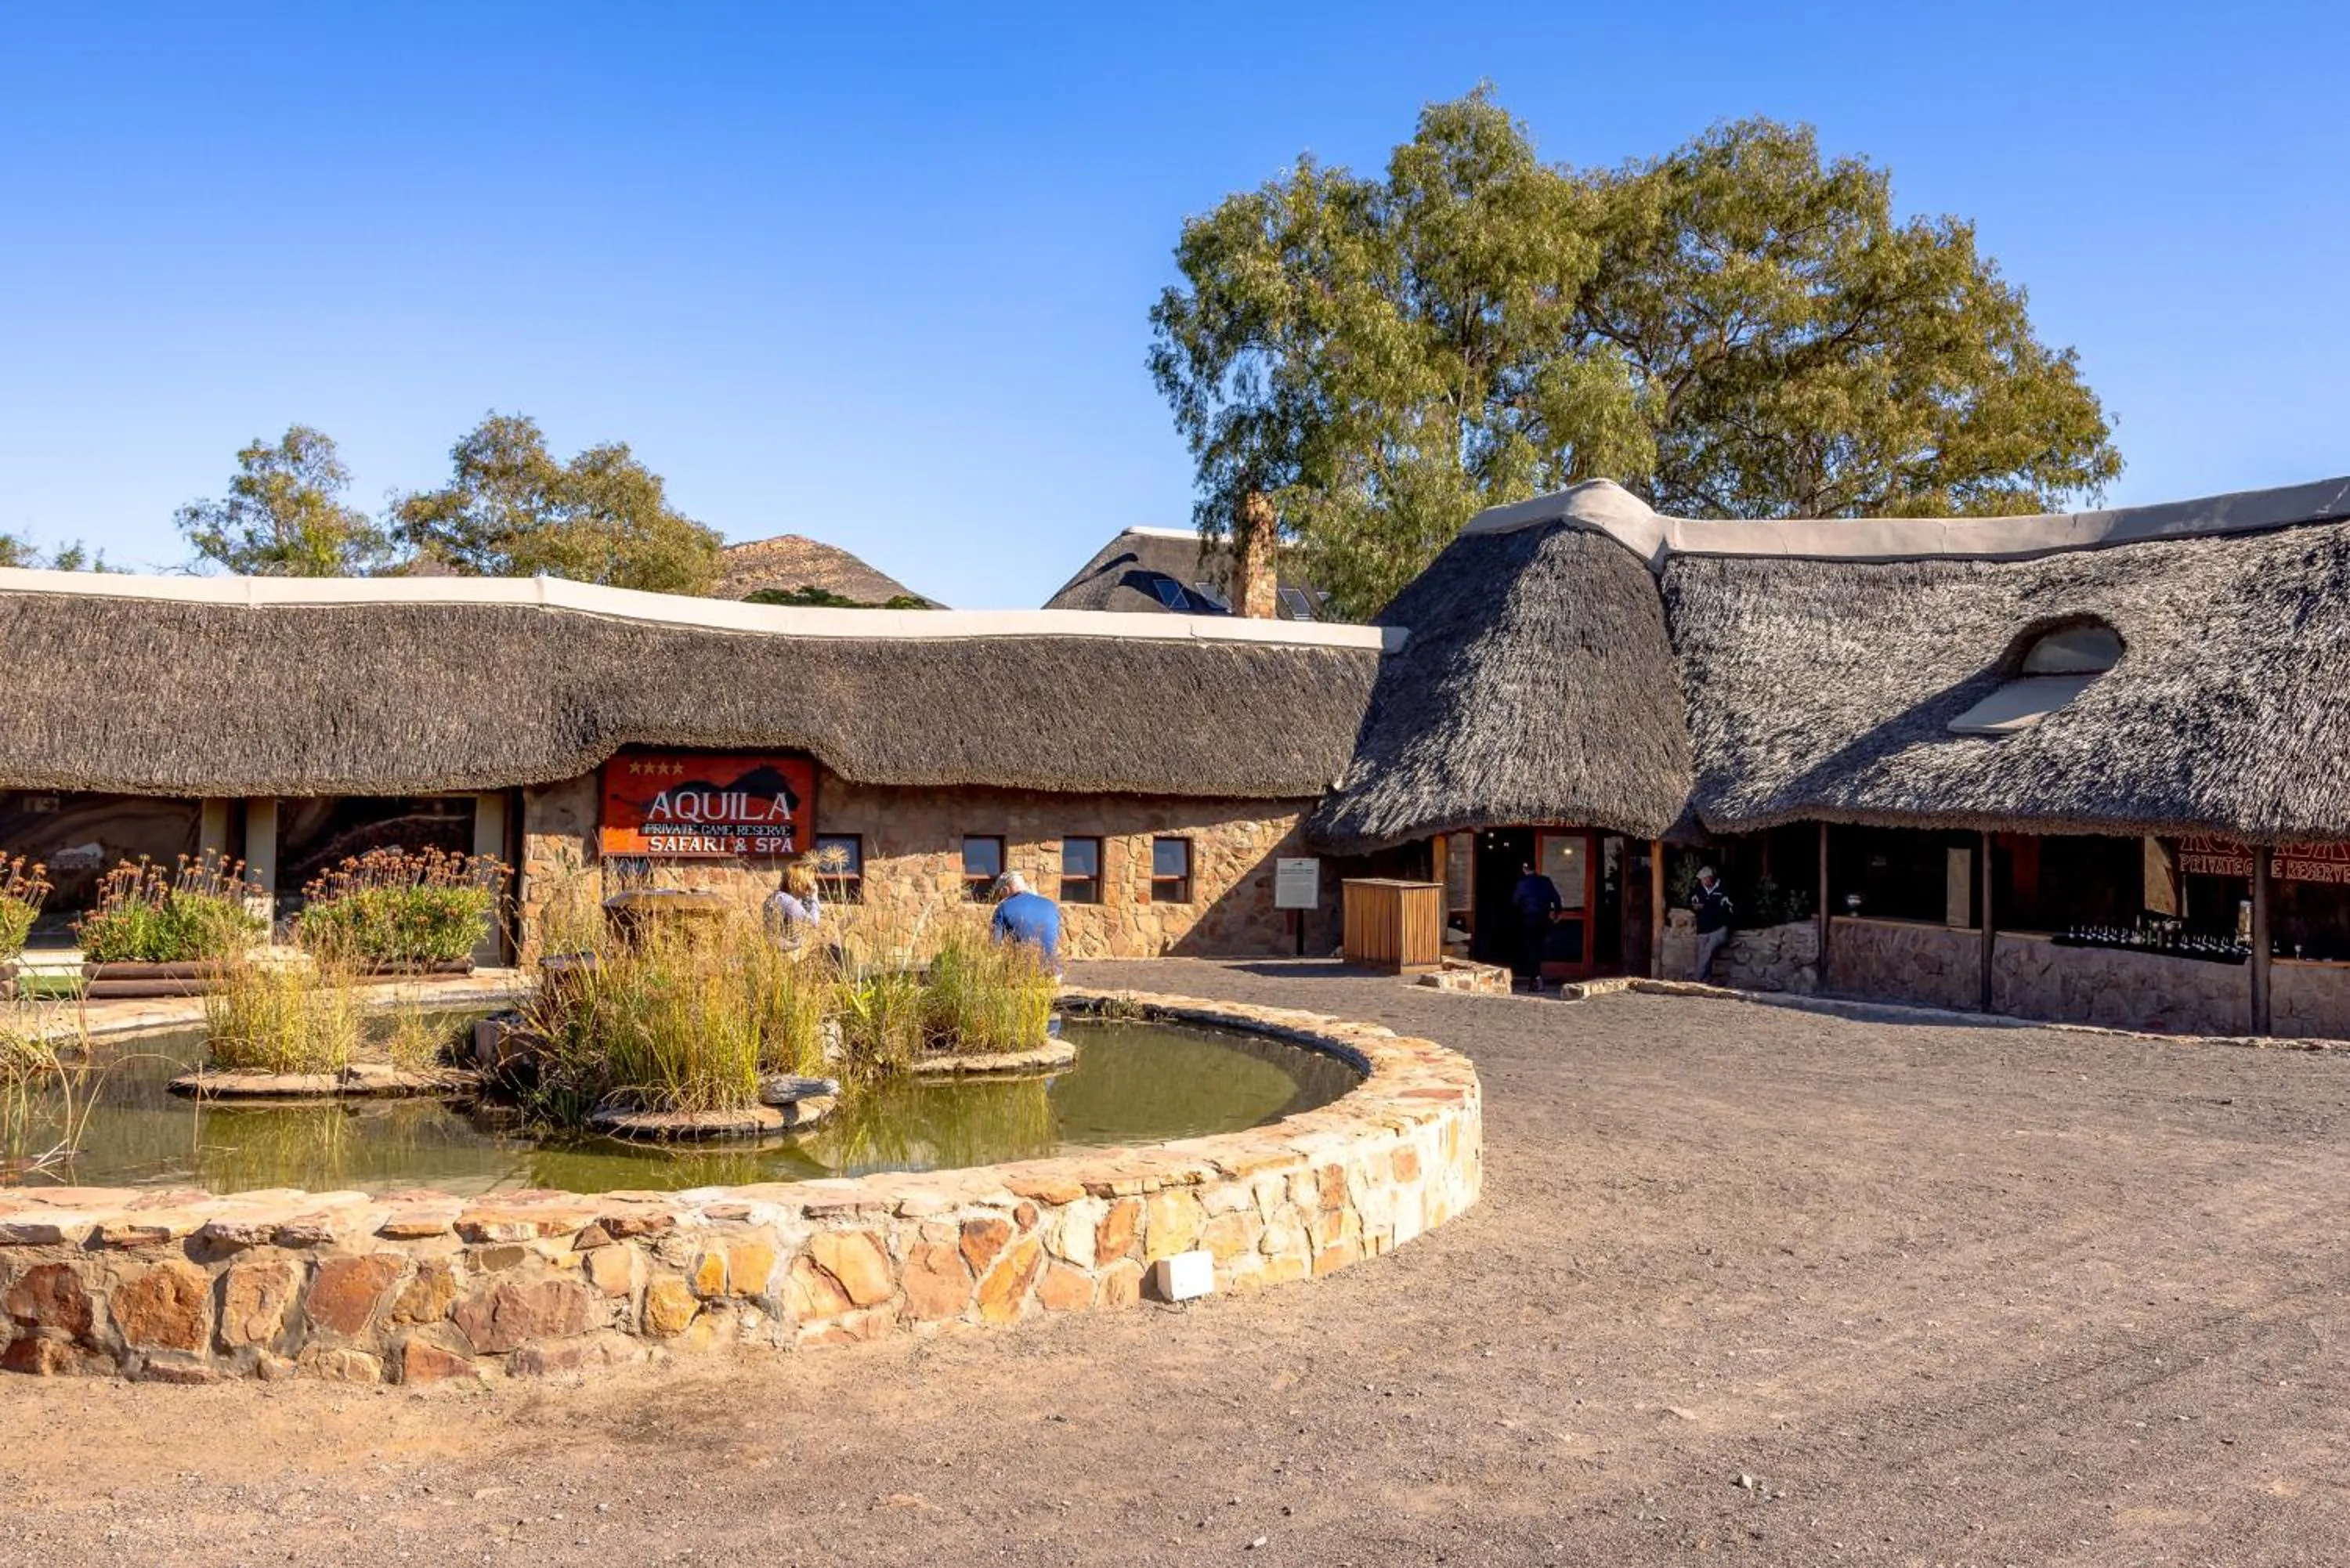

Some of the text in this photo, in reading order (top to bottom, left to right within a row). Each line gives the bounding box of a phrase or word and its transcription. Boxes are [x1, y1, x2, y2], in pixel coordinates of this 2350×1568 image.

[648, 791, 792, 823] AQUILA
[644, 823, 790, 836] PRIVATE GAME RESERVE
[649, 836, 794, 852] SAFARI & SPA
[2178, 854, 2243, 876] PRIVATE
[2286, 860, 2350, 883] RESERVE
